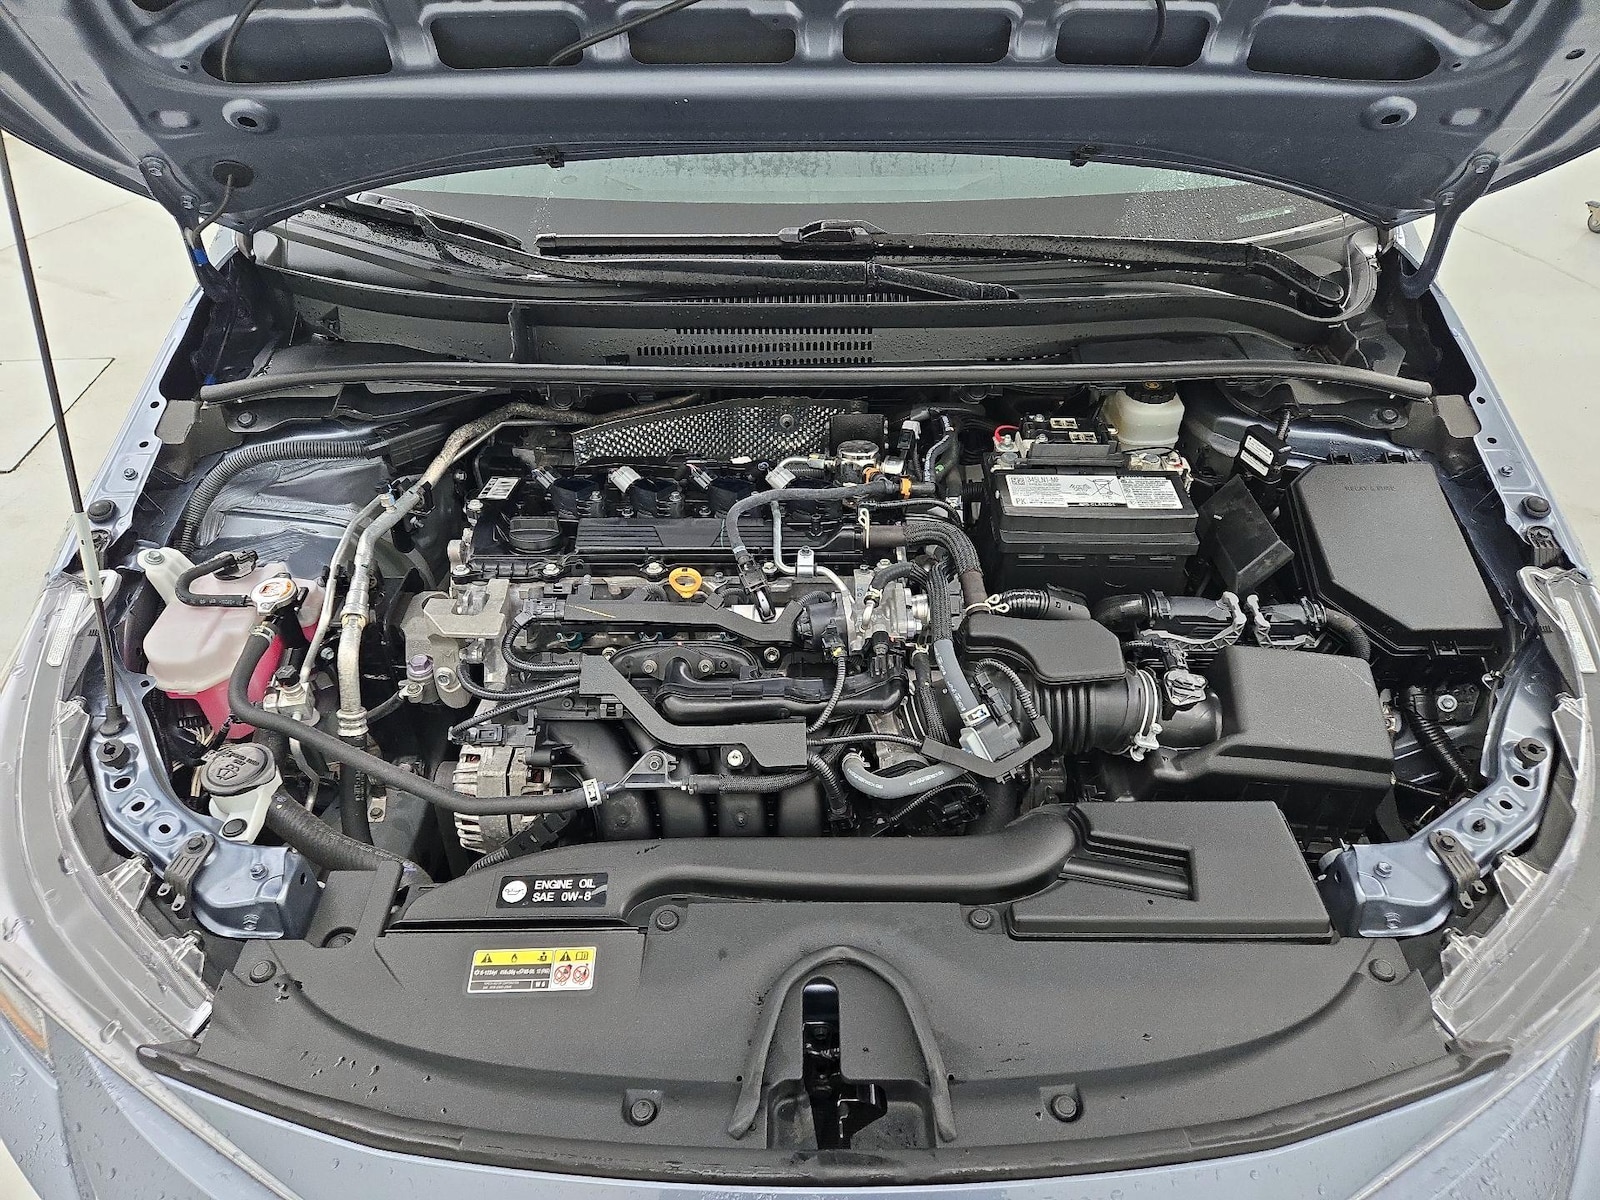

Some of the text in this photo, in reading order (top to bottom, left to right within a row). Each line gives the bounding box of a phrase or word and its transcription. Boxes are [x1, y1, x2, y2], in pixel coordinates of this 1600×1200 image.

[533, 878, 597, 890] ENGINE OIL
[531, 890, 593, 902] SAE 0W-8
